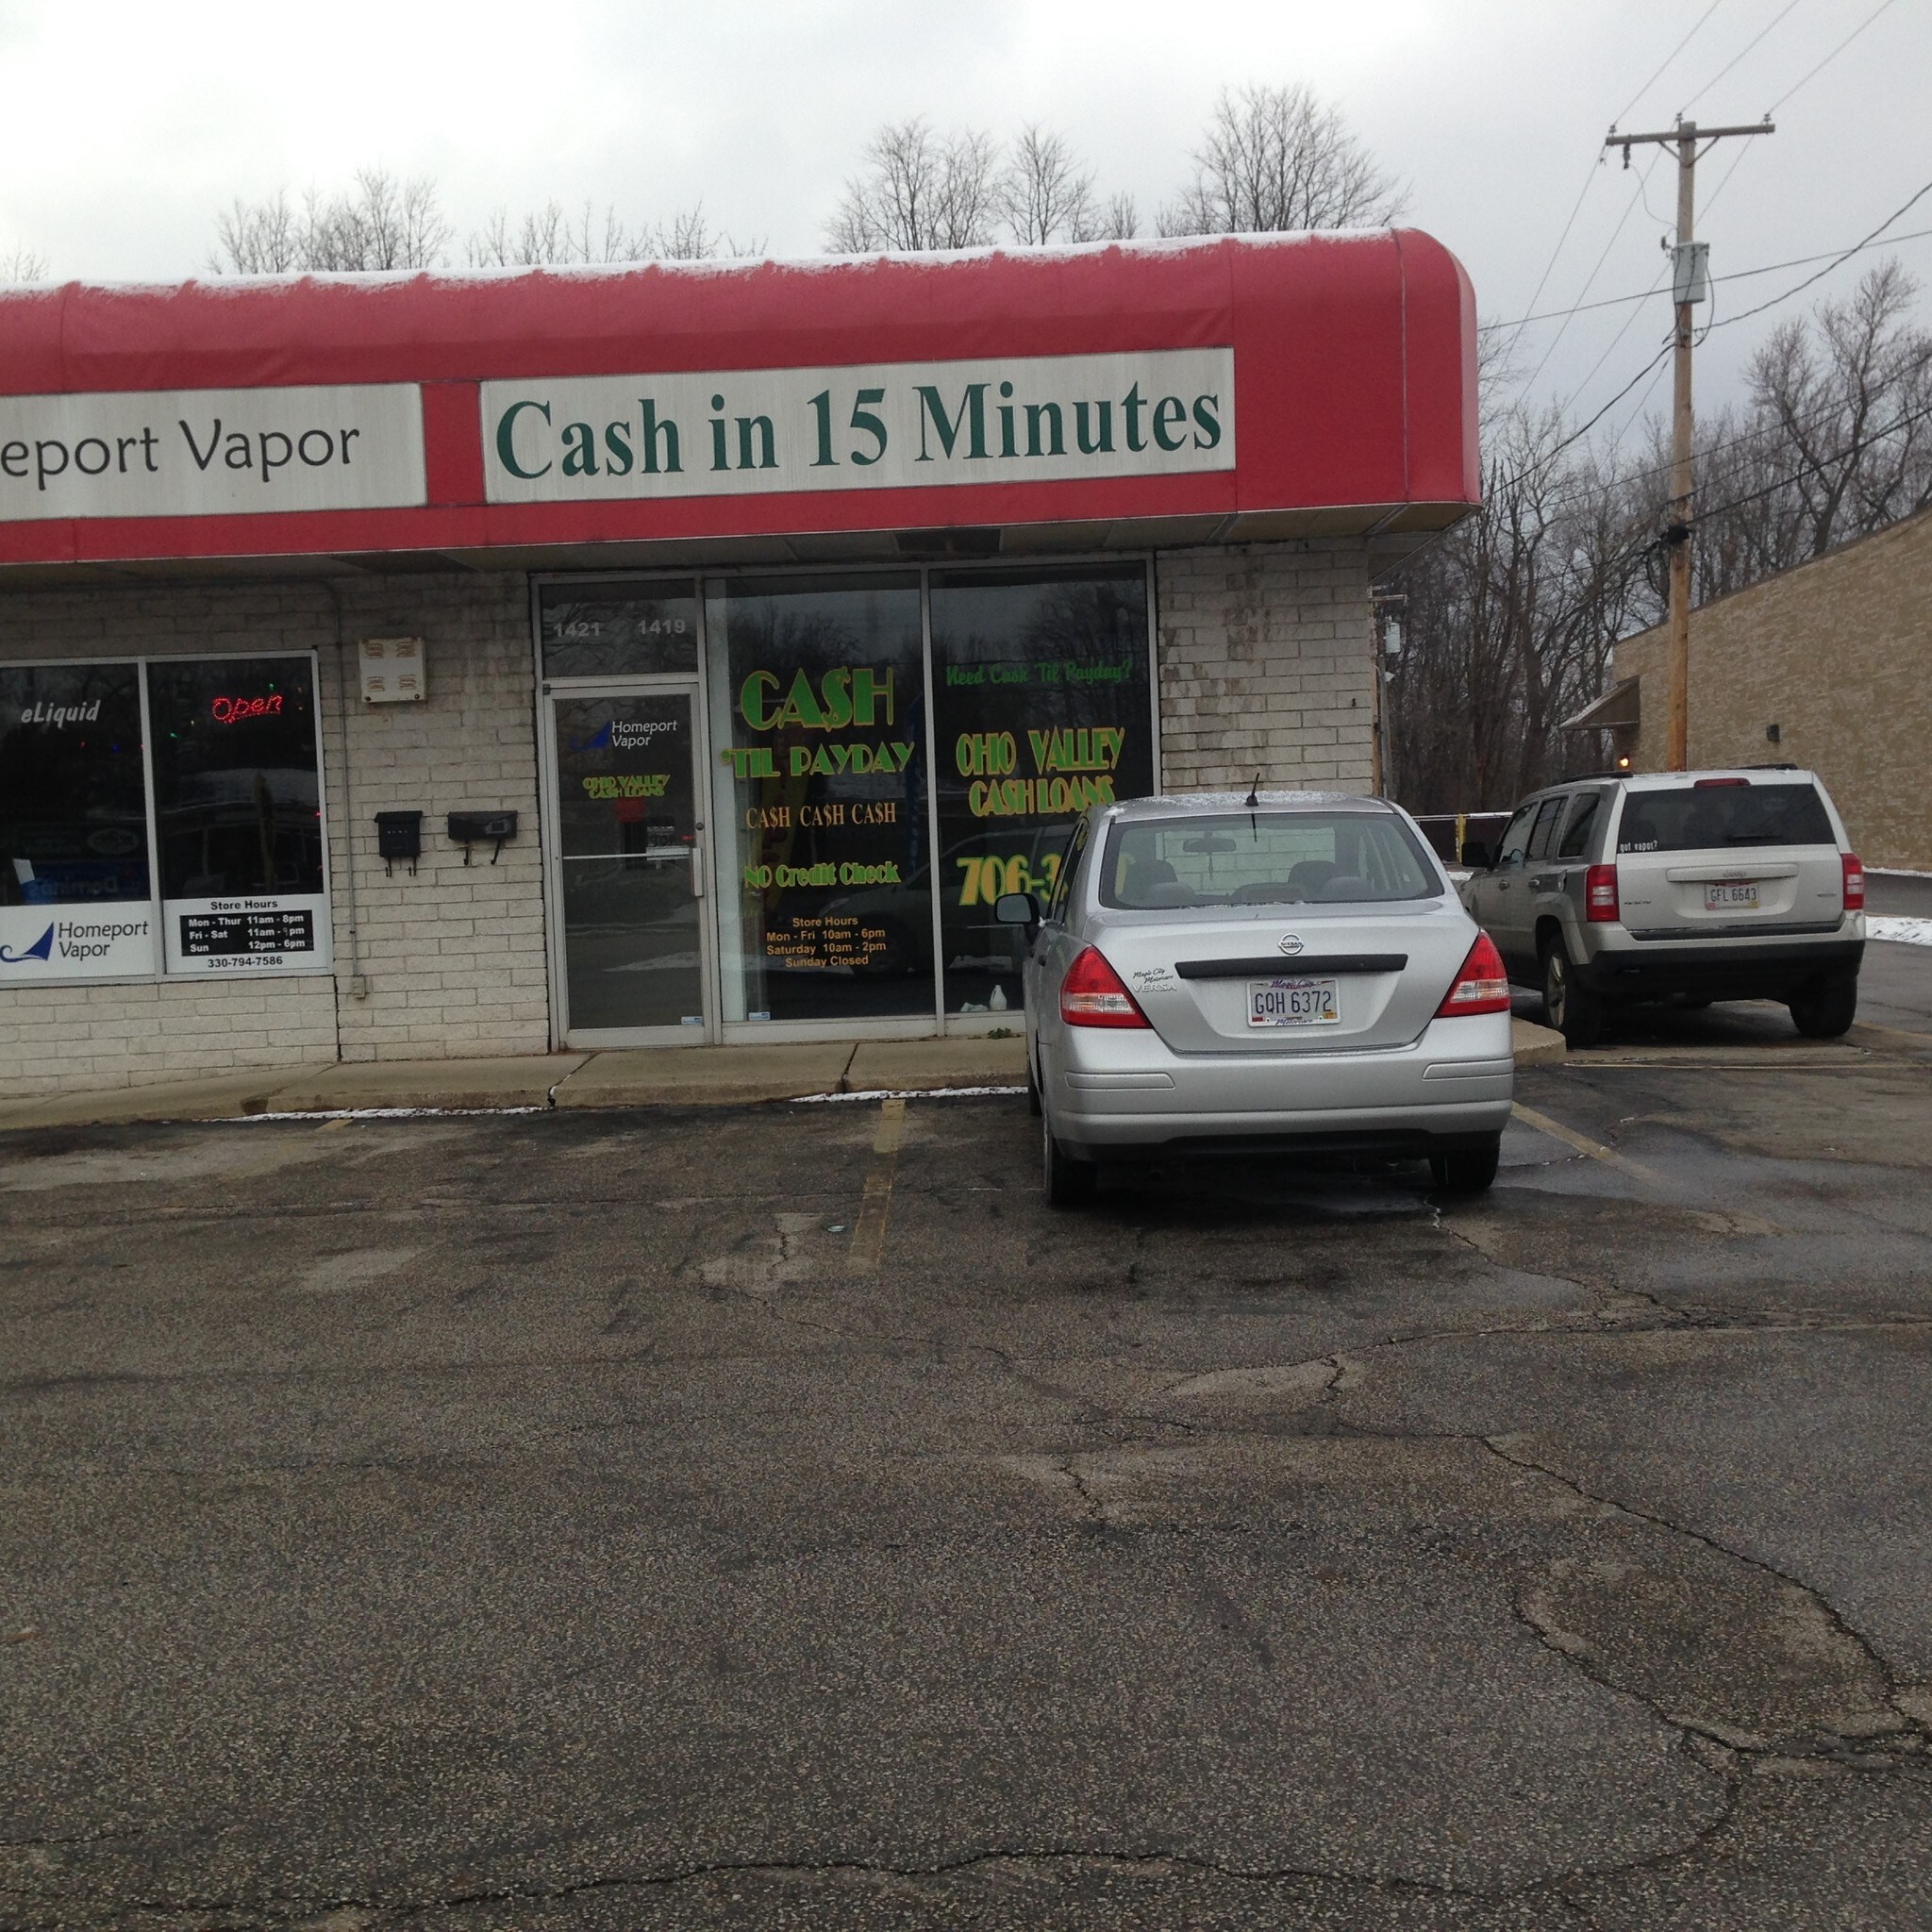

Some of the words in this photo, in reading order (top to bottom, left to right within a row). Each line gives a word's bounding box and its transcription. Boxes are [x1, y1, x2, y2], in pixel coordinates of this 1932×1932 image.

[496, 394, 684, 480] Cash
[709, 393, 780, 471] in
[807, 388, 889, 467] 15
[911, 380, 1223, 463] Minutes
[179, 418, 359, 482] Vapor
[554, 622, 600, 638] 1421
[638, 619, 686, 635] 1419
[945, 664, 986, 687] Need
[21, 700, 101, 728] eLiquid
[212, 695, 282, 724] Open
[612, 720, 677, 736] Homeport
[612, 735, 651, 749] Vapor
[956, 731, 1017, 776] OHIO
[1027, 724, 1124, 775] VALLEY
[790, 741, 915, 776] PAYDAY
[617, 774, 672, 788] VALLEY
[625, 786, 664, 797] LOANS
[969, 779, 1034, 817] CASH
[1037, 774, 1116, 814] LOANS
[1620, 842, 1631, 853] got
[743, 864, 773, 889] NO
[775, 862, 837, 888] Credit
[840, 860, 901, 885] Check
[1710, 889, 1728, 902] GFL
[1732, 888, 1757, 901] 6643
[210, 901, 242, 910] Store
[244, 899, 278, 909] Hours
[189, 918, 209, 927] Mon
[218, 916, 242, 925] Thur
[246, 915, 275, 924] 11am
[283, 914, 304, 924] 8pm
[792, 917, 822, 928] Store
[824, 916, 858, 926] Hours
[58, 921, 149, 941] Homeport
[190, 931, 202, 940] Fri
[211, 929, 228, 939] Sat
[247, 927, 275, 937] 11am
[766, 932, 791, 941] Mon
[801, 930, 816, 940] Fri
[823, 930, 851, 940] 10am
[861, 928, 886, 940] 6pm
[58, 941, 110, 961] Vapor
[190, 943, 209, 953] Sun
[248, 941, 275, 951] 12pm
[284, 939, 306, 949] 6pm
[766, 943, 816, 956] Saturday
[823, 942, 852, 953] 10am
[862, 941, 887, 954] 2pm
[208, 956, 283, 969] 330-794-7586
[785, 956, 827, 969] Sunday
[830, 955, 869, 966] Closed
[1132, 983, 1177, 992] VERSA
[1255, 991, 1285, 1014] GQH
[1291, 991, 1332, 1013] 6372
